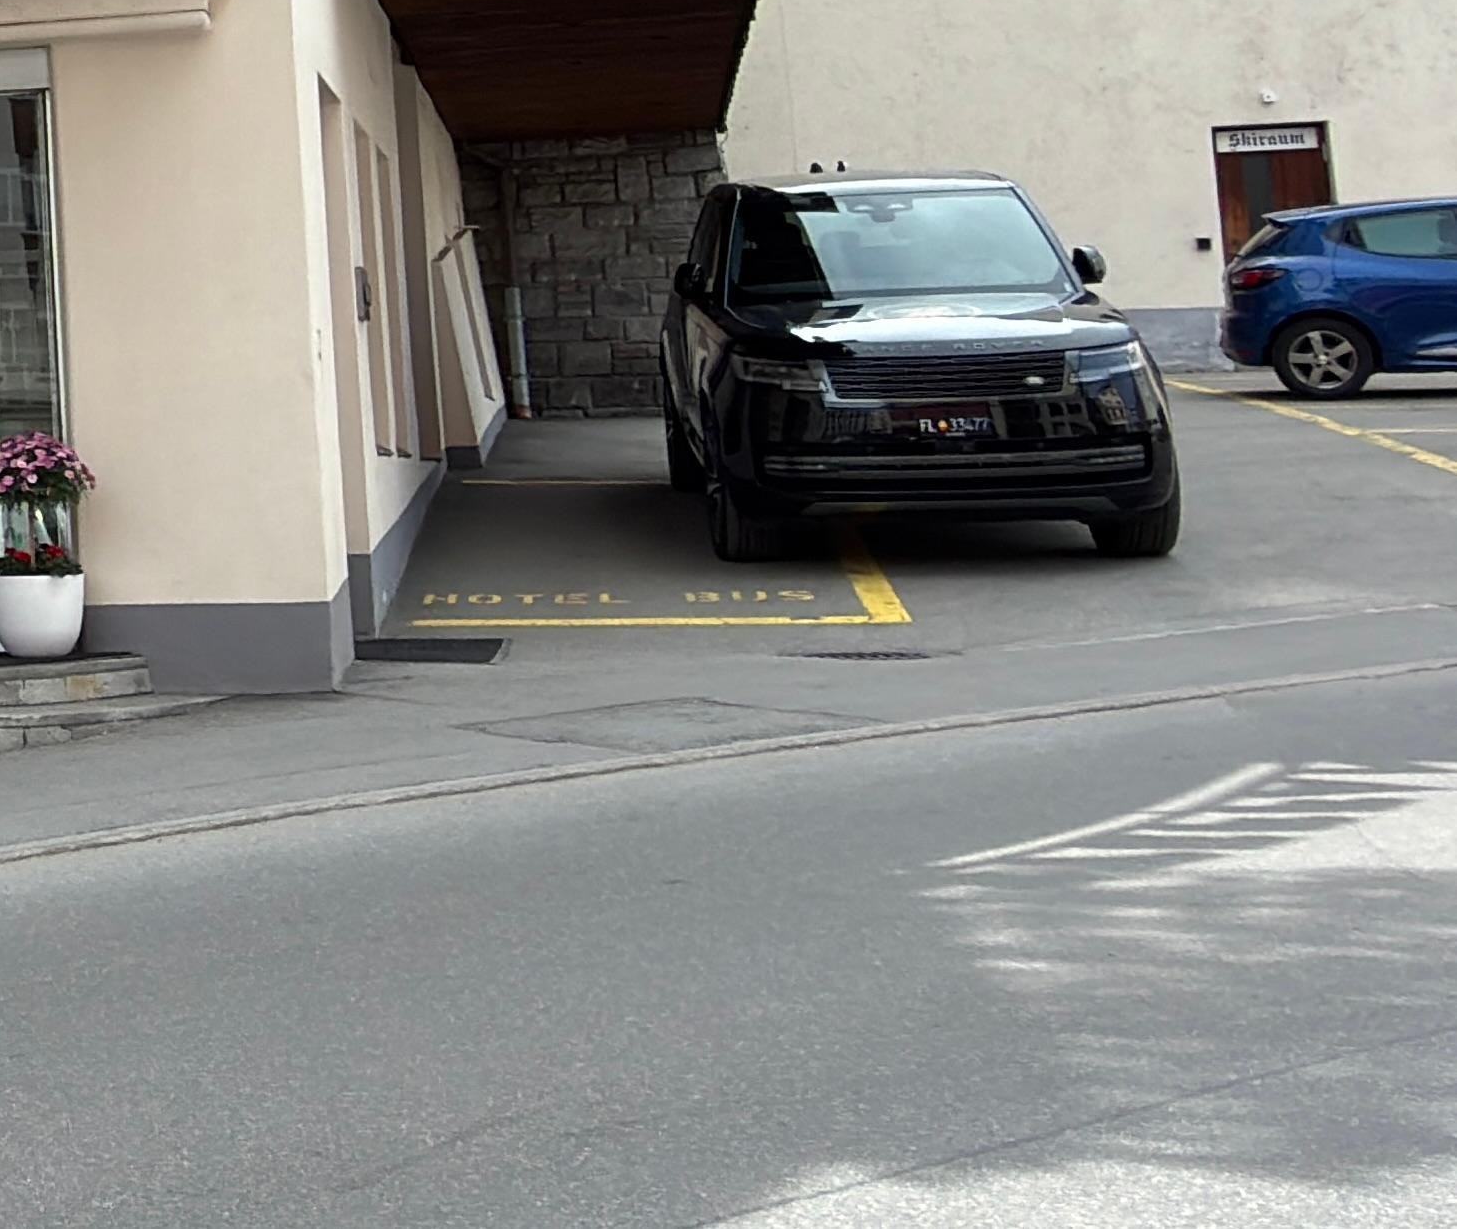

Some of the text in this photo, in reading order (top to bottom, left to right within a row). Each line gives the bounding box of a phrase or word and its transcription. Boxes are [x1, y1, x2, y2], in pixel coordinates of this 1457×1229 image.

[1228, 132, 1306, 148] Skiraum
[918, 418, 938, 433] FL
[422, 589, 815, 605] HOTEL BUS
